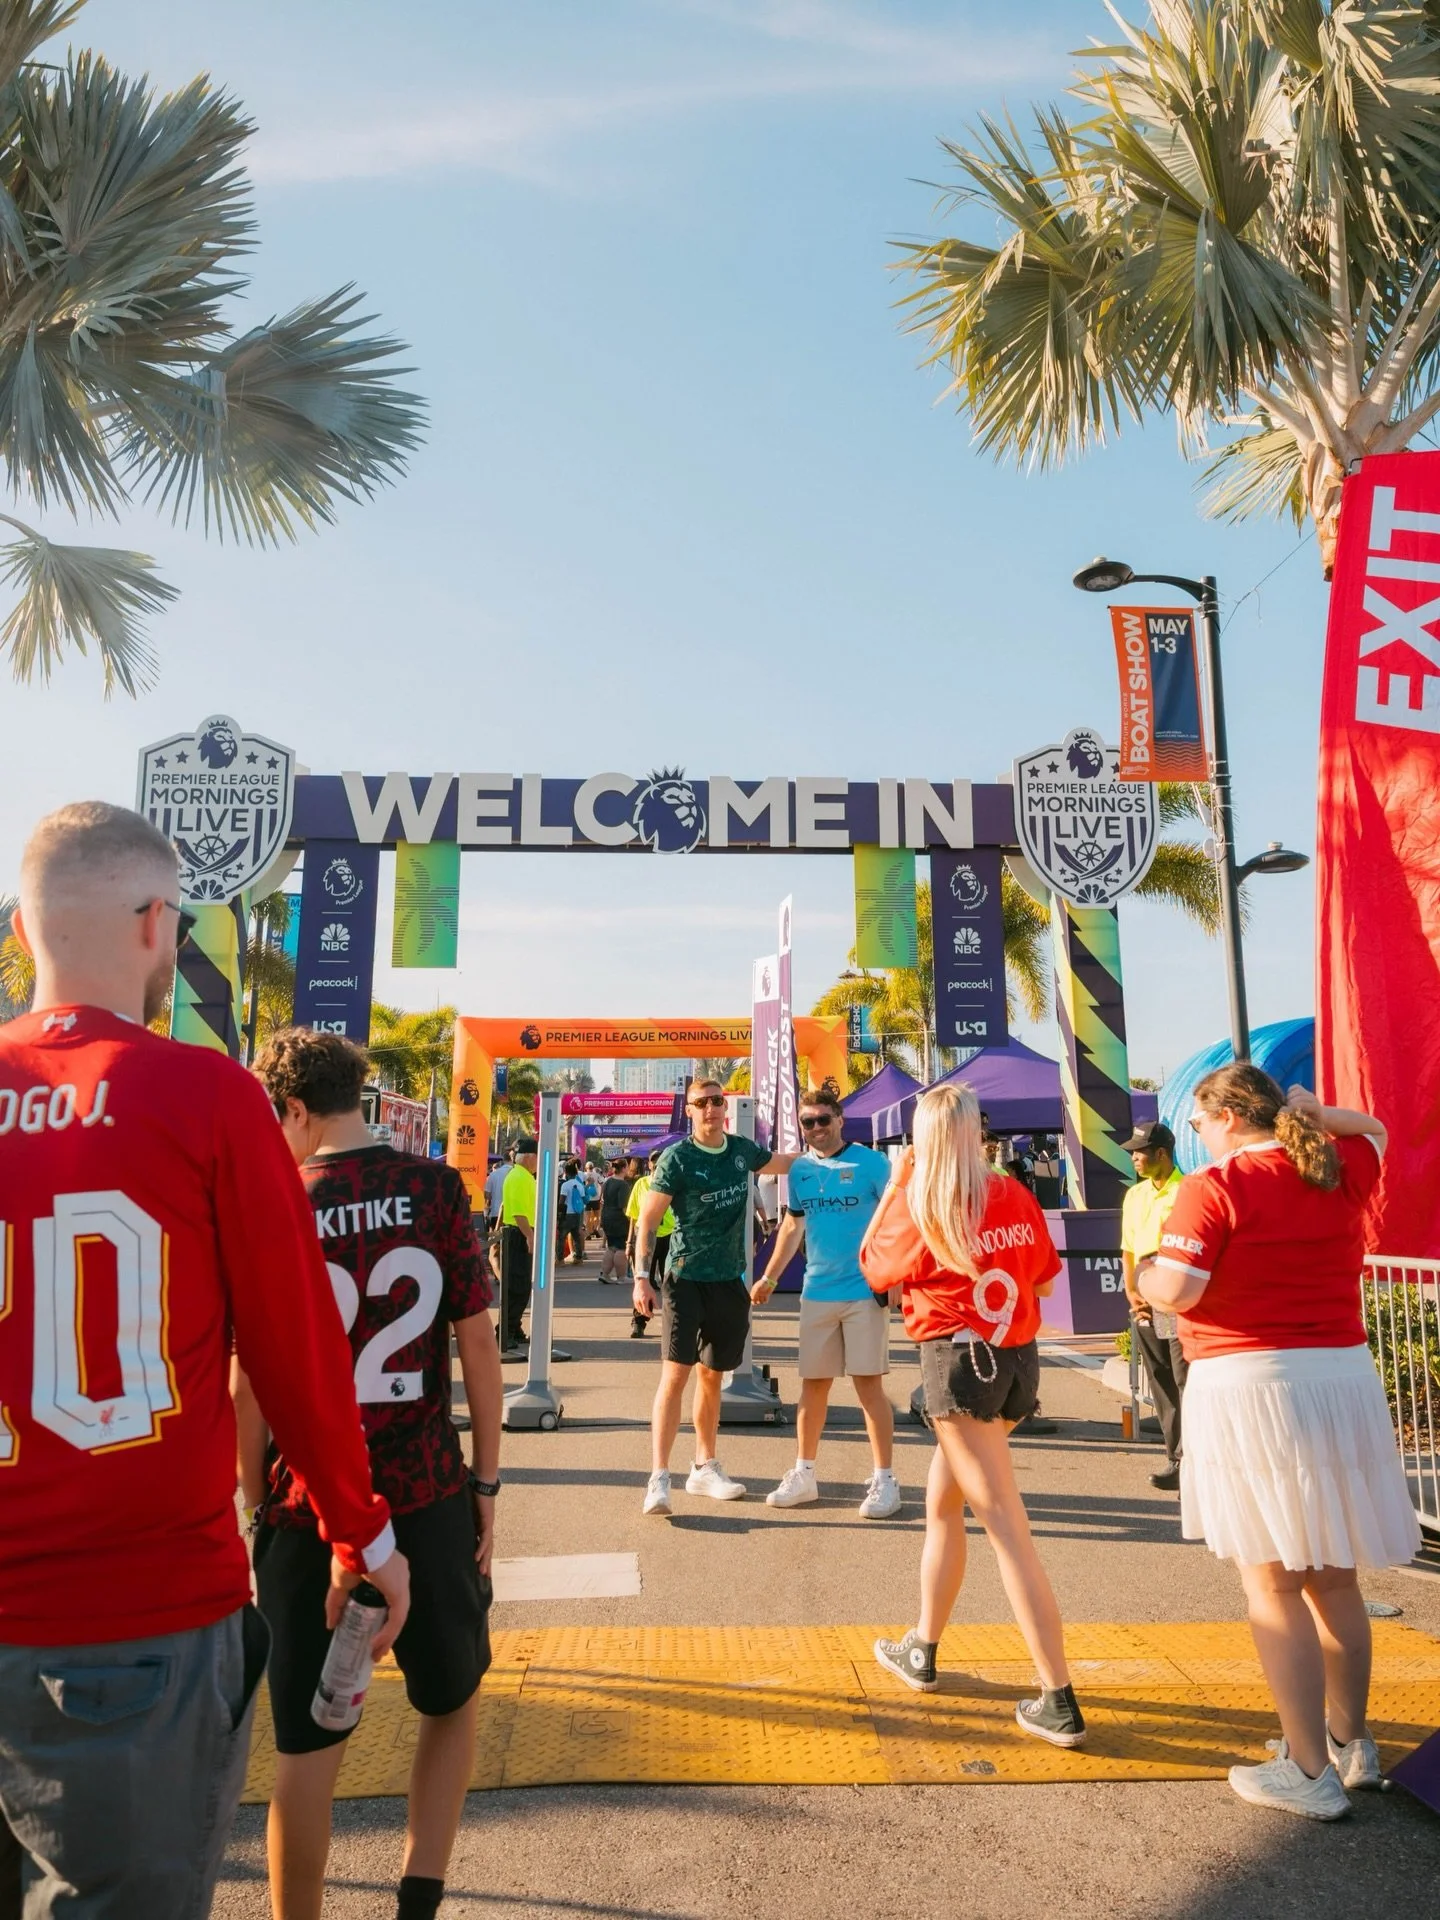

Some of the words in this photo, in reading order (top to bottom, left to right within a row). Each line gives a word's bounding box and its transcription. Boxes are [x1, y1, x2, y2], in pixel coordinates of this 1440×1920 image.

[1355, 485, 1440, 734] EXIT
[1148, 618, 1188, 636] MAY
[1120, 611, 1148, 691] SHOW
[1150, 637, 1177, 655] 1-3
[1129, 693, 1150, 764] BOAT
[151, 773, 217, 785] PREMIER
[221, 774, 280, 785] LEAGUE
[1027, 782, 1087, 794] PREMIER
[1091, 783, 1145, 795] LEAGUE
[149, 787, 279, 805] MORNINGS
[1028, 796, 1146, 813] MORNINGS
[176, 807, 249, 832] LIVE
[878, 777, 974, 849] IN
[1055, 815, 1121, 839] LIVE
[321, 941, 349, 951] NBC
[954, 944, 981, 955] NBC
[308, 976, 354, 991] peacock
[947, 979, 989, 993] peacock
[852, 1003, 861, 1023] SHO
[546, 1031, 602, 1043] PREMIER
[605, 1031, 655, 1042] LEAGUE
[658, 1031, 727, 1042] MORNINGS
[730, 1030, 752, 1041] LIV
[852, 1023, 861, 1048] BOAT
[780, 996, 798, 1155] NFO/LOST
[82, 1080, 115, 1128] J.
[584, 1099, 615, 1107] PREMIER
[615, 1099, 643, 1107] LEAGUE
[758, 1075, 769, 1121] 21+
[456, 1138, 475, 1146] NBC
[700, 1181, 747, 1203] ETIHAD
[801, 1196, 860, 1209] ETIHAD
[314, 1196, 413, 1240] KITIKE
[971, 1223, 1035, 1257] ANDOWSKI
[972, 1267, 1020, 1348] 9
[0, 1188, 181, 1466] 0
